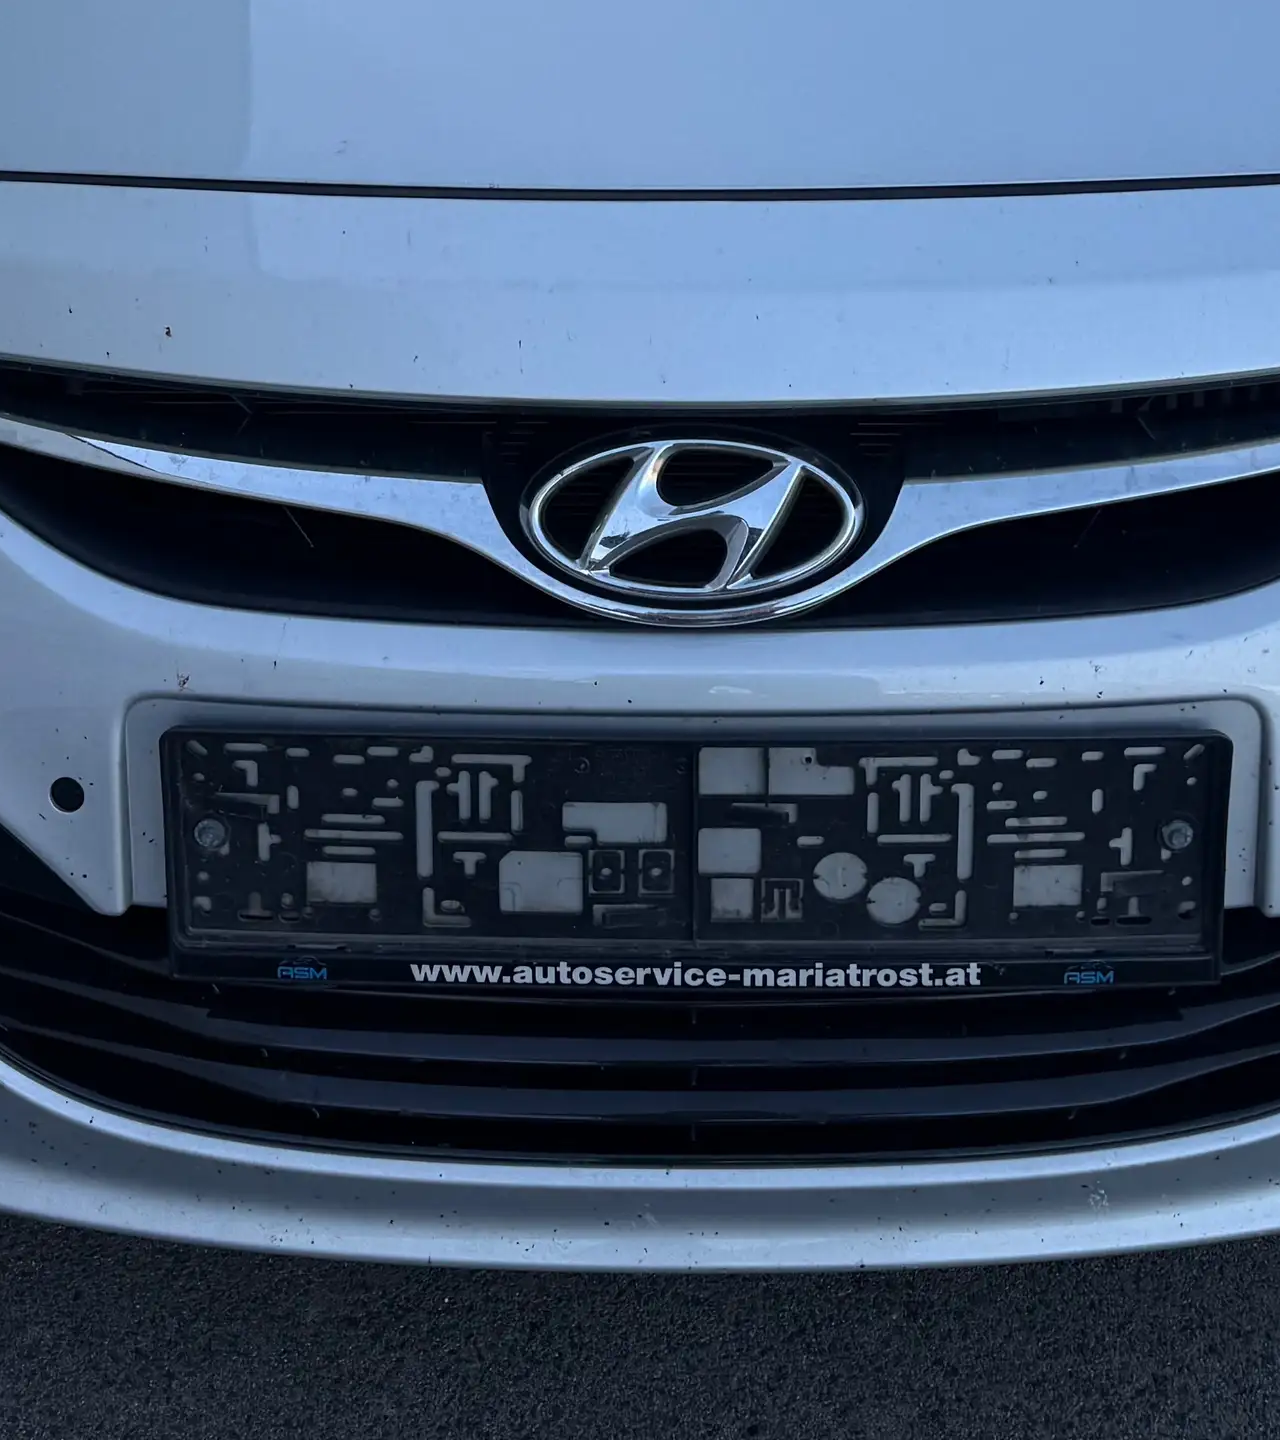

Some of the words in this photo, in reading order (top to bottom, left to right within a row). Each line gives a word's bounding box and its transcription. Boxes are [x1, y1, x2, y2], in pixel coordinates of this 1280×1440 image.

[277, 966, 328, 980] ASM
[410, 960, 981, 987] www.autoservice-mariatrost.at
[1064, 969, 1114, 984] ASM
